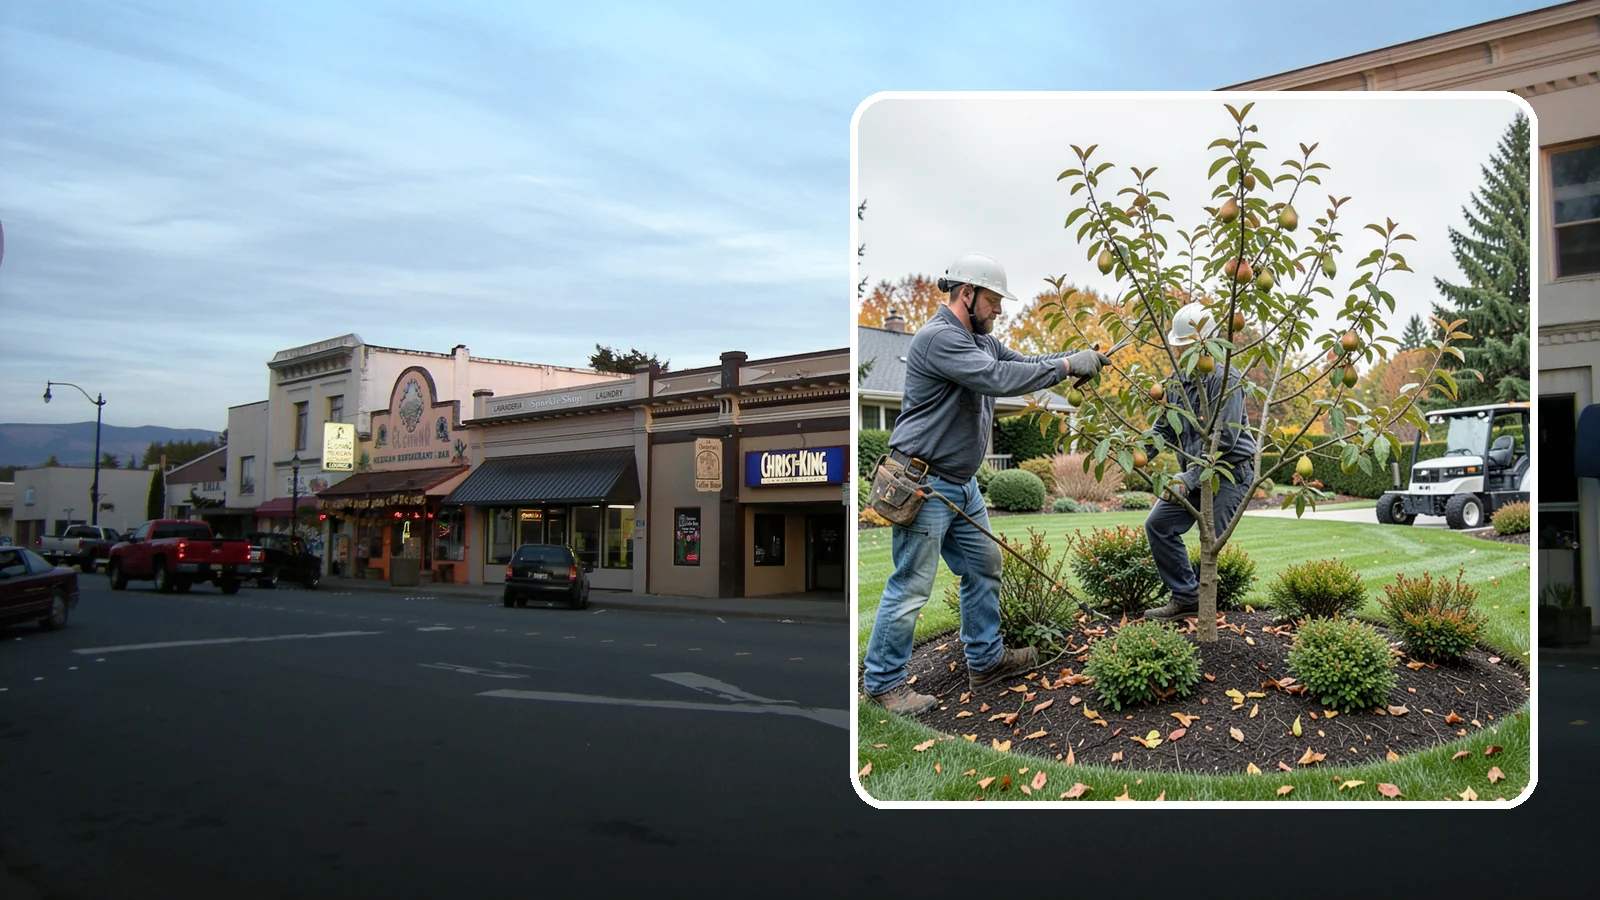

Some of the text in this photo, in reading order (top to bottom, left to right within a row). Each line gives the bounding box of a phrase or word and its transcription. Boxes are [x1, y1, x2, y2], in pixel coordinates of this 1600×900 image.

[530, 394, 583, 408] Sparkle Shop
[595, 388, 624, 400] LAUNDRY
[493, 402, 522, 413] LAVANDERIA
[373, 450, 450, 465] MEXICAN RESTAURANT BAR
[761, 450, 827, 478] CHRIST KING
